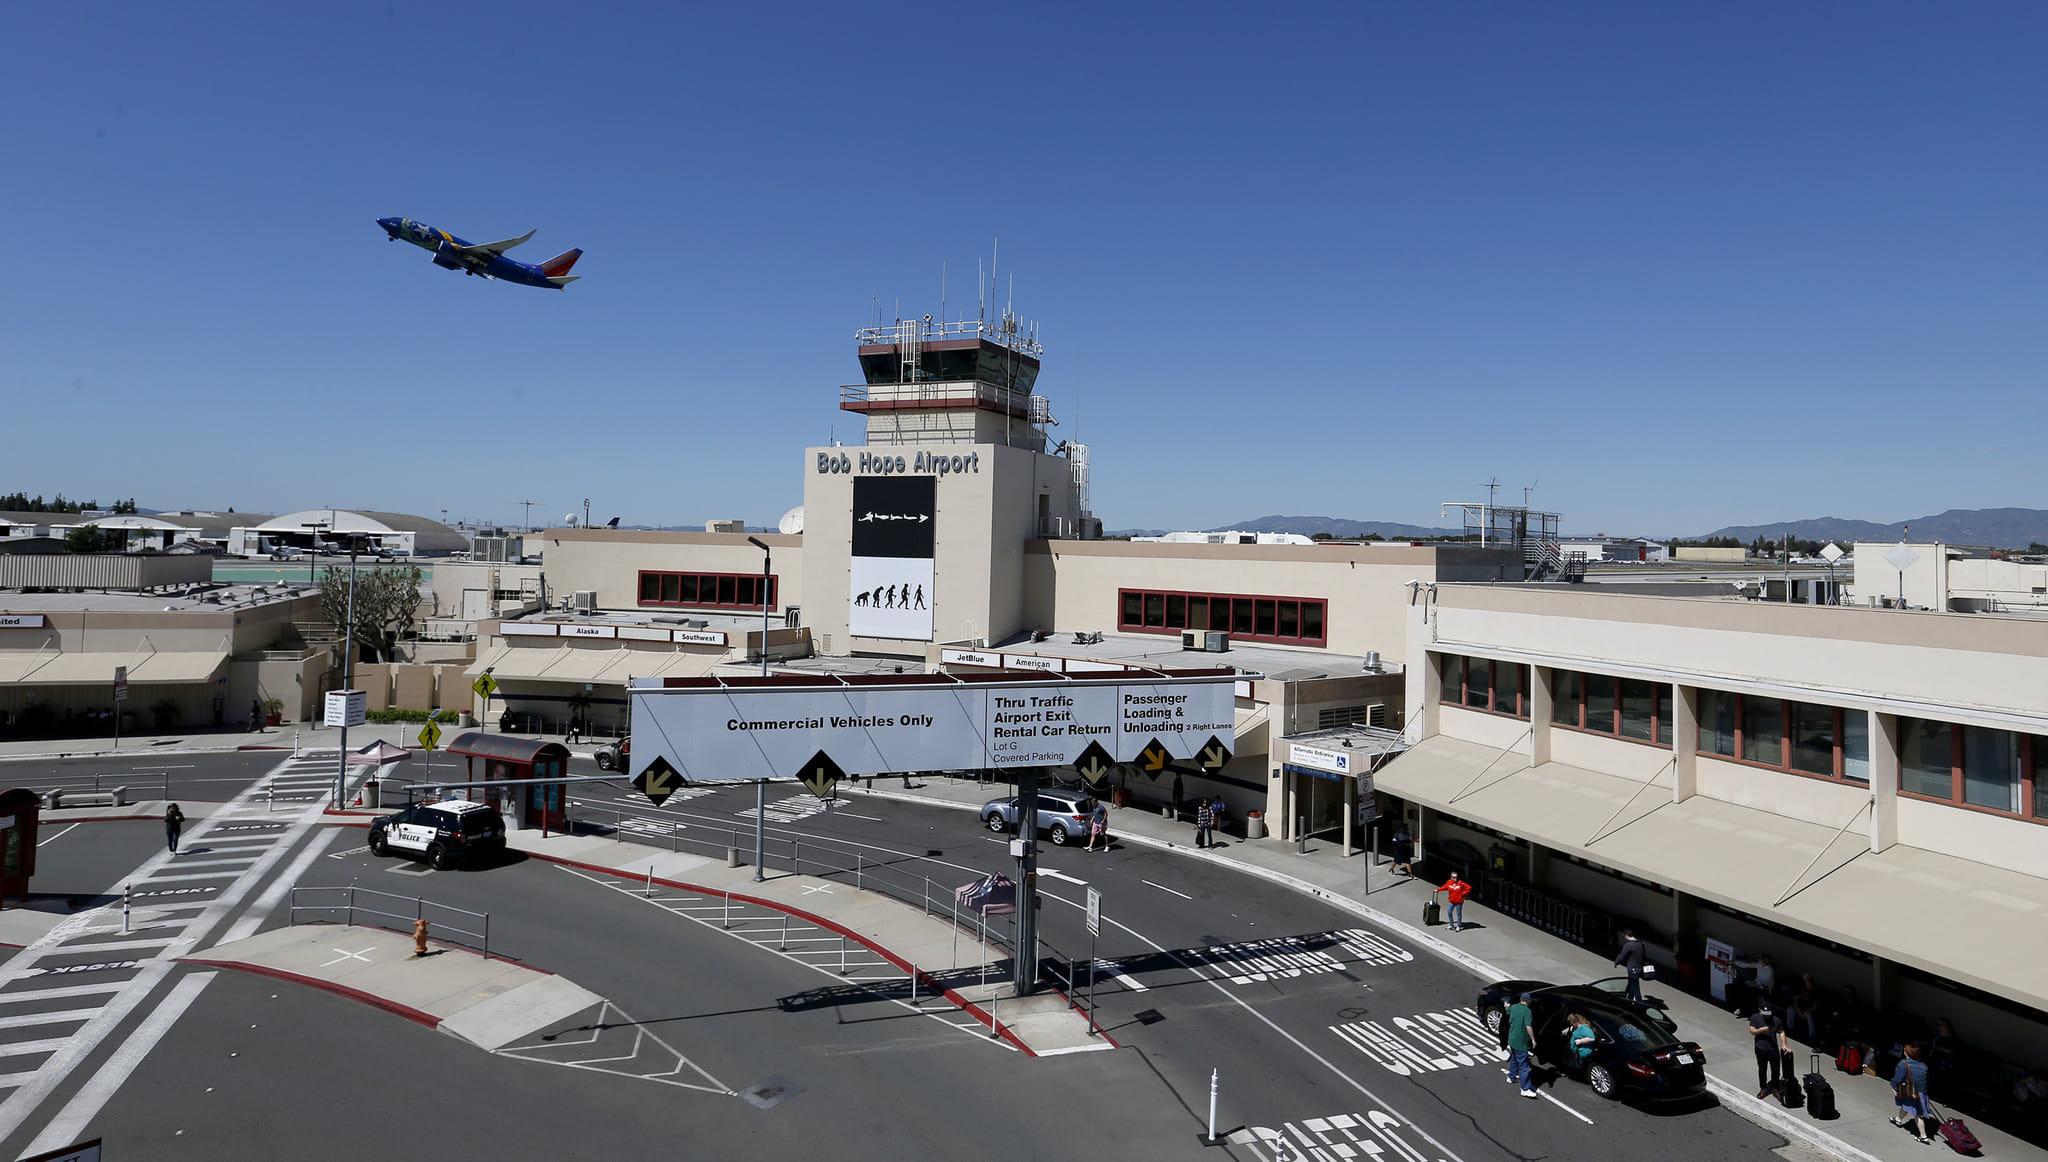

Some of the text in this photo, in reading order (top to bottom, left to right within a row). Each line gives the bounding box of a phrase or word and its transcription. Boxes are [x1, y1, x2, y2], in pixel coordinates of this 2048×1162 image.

[817, 451, 979, 477] Bob Hope Airport
[681, 633, 716, 642] Southwest
[956, 654, 985, 663] JetBlue
[1016, 658, 1050, 667] American
[995, 696, 1073, 708] Thru Traffic
[1124, 693, 1187, 706] Passenger
[994, 711, 1072, 725] Airport Exit
[1124, 708, 1184, 720] Loading &
[727, 714, 933, 731] Commercial Vehicles Only
[1124, 721, 1183, 733] Unloading
[1193, 724, 1210, 732] Right
[1212, 722, 1232, 730] Lanes
[994, 724, 1111, 738] Rental Car Return
[993, 742, 1017, 751] Lot G
[993, 752, 1064, 763] Covered Parking
[400, 832, 420, 842] POLICE
[147, 887, 204, 897] LOOK
